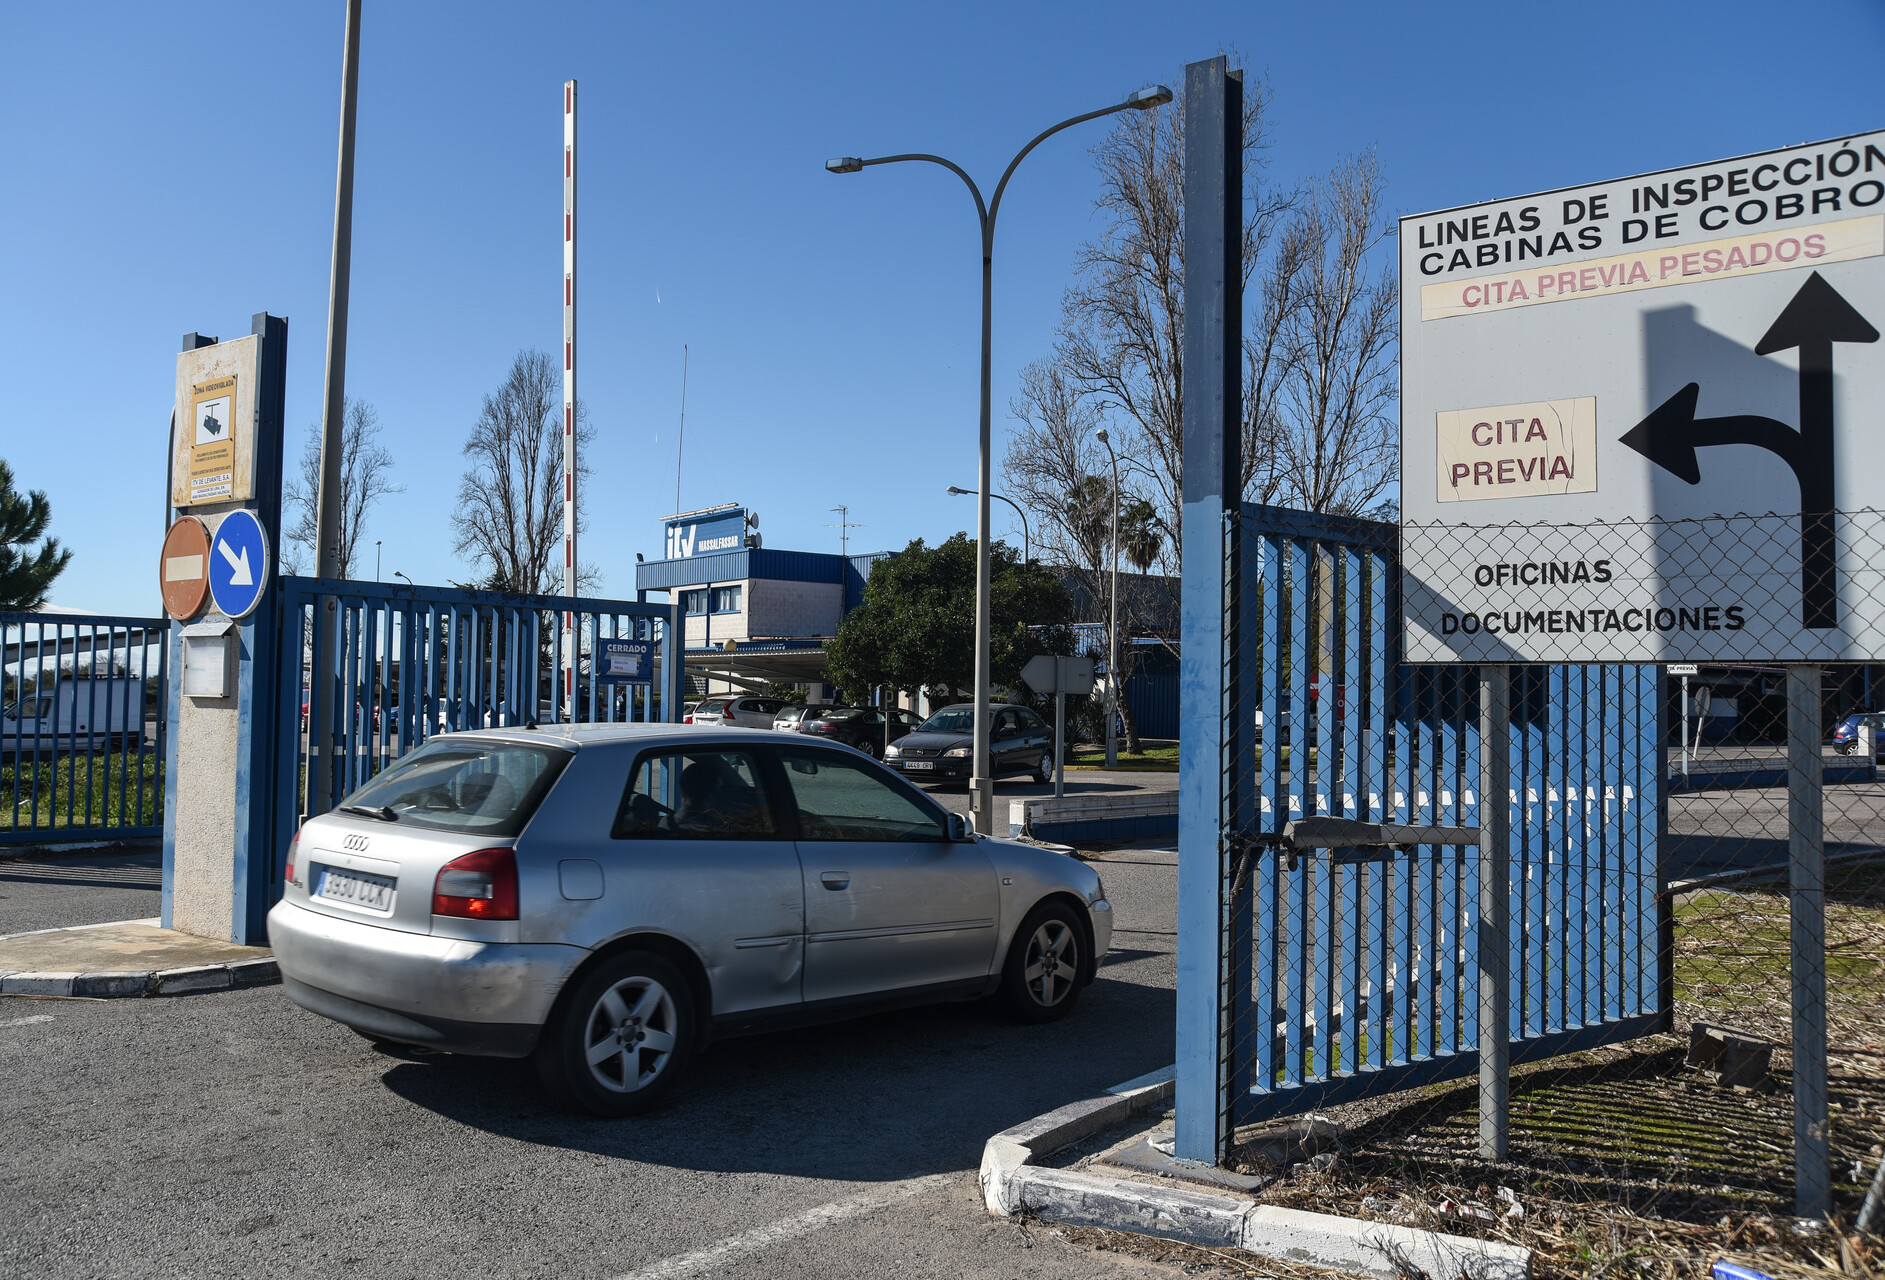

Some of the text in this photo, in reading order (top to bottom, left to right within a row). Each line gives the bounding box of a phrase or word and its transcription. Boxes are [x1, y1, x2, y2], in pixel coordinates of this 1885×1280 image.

[1419, 141, 1885, 249] LINEAS DE INSPECCIÓN
[1419, 180, 1885, 276] CABINAS DE COBRO
[1462, 233, 1826, 308] CITA PREVIA PESADOS
[1471, 417, 1548, 447] CITA
[1451, 455, 1572, 487] PREVIA
[698, 535, 739, 552] MASSALFASSAR
[1474, 559, 1613, 587] OFICINAS
[1441, 606, 1746, 636] DOCUMENTACIONES
[606, 643, 647, 653] CERRADO
[885, 690, 894, 710] P
